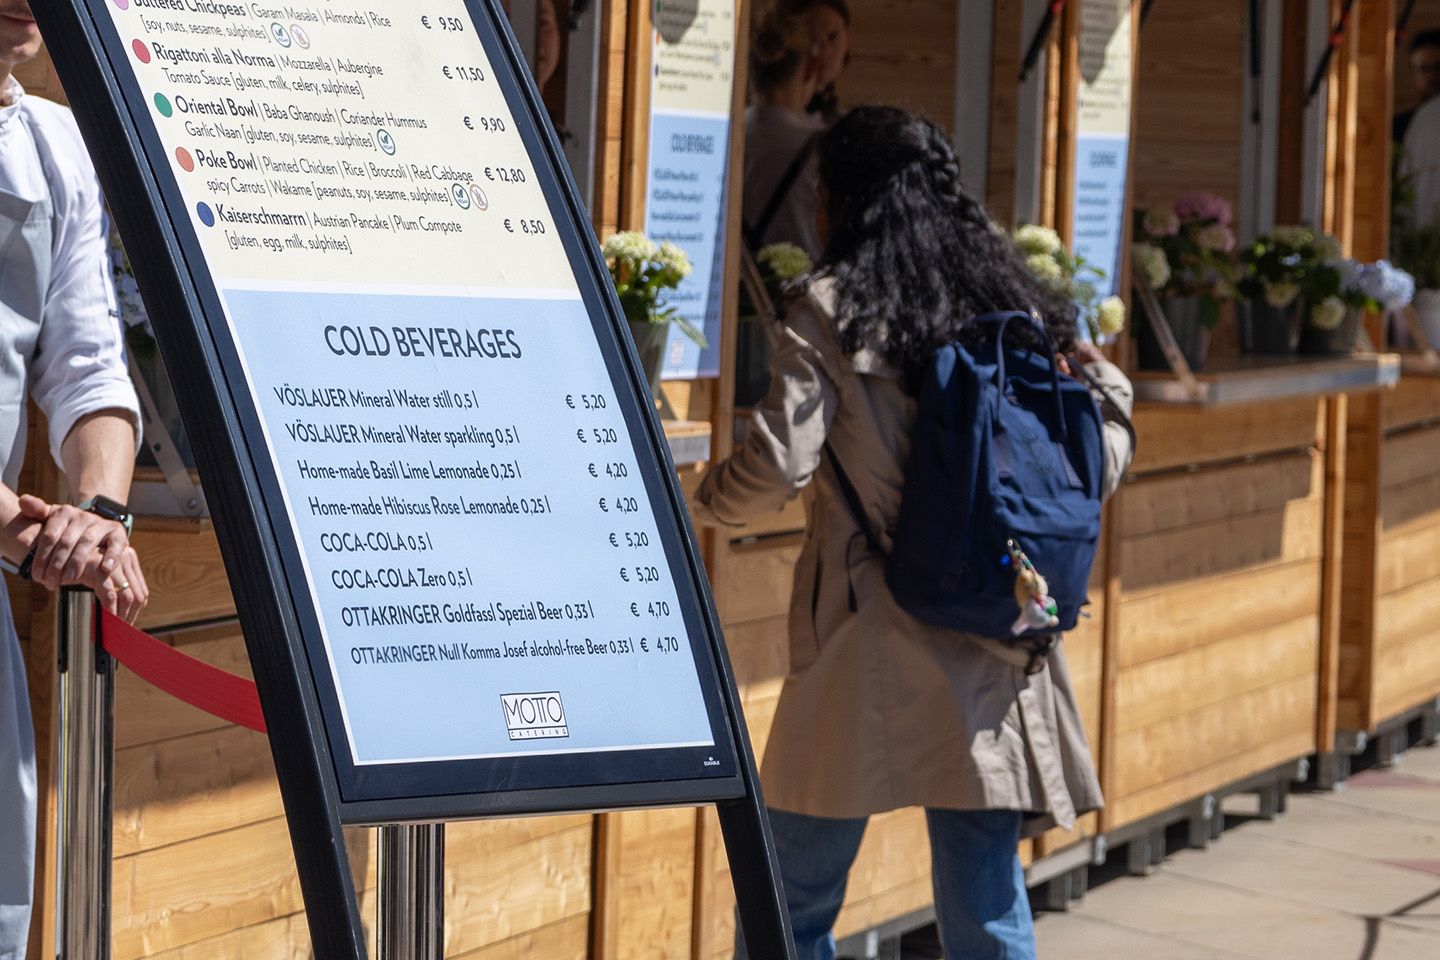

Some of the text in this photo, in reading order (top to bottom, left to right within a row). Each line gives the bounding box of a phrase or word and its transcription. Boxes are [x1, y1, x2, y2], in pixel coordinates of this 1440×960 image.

[139, 14, 272, 43] [soy, nuts, sesame, sulphites]
[251, 3, 285, 19] Garam
[284, 6, 319, 22] Masala
[324, 9, 367, 25] Almonds
[369, 11, 392, 28] Rice
[421, 15, 432, 30] €
[438, 16, 464, 32] 9,50
[152, 42, 485, 83] Rigattoni alla Norma Mozzarella Aubergine € 11,50
[161, 67, 365, 99] Tomato Sauce [gluten, milk, celery, sulphites]
[175, 95, 506, 133] Oriental Bowl Baba Ghanoush Coriander Hummus € 9,90
[184, 121, 378, 152] Garlic Naan [gluten, soy, sesame, sulphites]
[195, 148, 527, 184] Poke Bowl Planted Chicken Rice Broccoli Red Cabbage € 12,80
[206, 176, 454, 207] spicy Carrots Wakame [peanuts, soy, sesame, sulphites]
[215, 203, 546, 236] Kaiserschmarrn Austrian Pancake Plum Compote € 8,50
[224, 229, 353, 254] [gluten, egg, milk, sulphites]
[323, 325, 523, 359] COLD BEVERAGES
[273, 383, 350, 408] VÖSLAUER
[349, 388, 395, 408] Mineral
[393, 388, 433, 408] Water
[434, 390, 453, 408] still
[453, 392, 473, 411] 0,5
[565, 395, 576, 410] €
[582, 394, 607, 411] 5,20
[285, 418, 360, 444] VÖSLAUER
[359, 424, 406, 444] Mineral
[404, 424, 442, 444] Water
[444, 424, 496, 449] sparkling
[495, 428, 514, 446] 0,5
[576, 429, 588, 444] €
[593, 428, 618, 446] 5,20
[297, 459, 371, 480] Home-made
[370, 460, 400, 480] Basil
[399, 460, 430, 480] Lime
[429, 460, 490, 480] Lemonade
[490, 463, 516, 481] 0,25
[588, 463, 599, 478] €
[605, 462, 628, 480] 4,20
[308, 496, 383, 516] Home-made
[381, 496, 432, 516] Hibiscus
[430, 496, 461, 516] Rose
[459, 495, 520, 515] Lemonade
[520, 498, 545, 516] 0,25
[599, 497, 609, 512] €
[616, 497, 639, 515] 4,20
[320, 532, 408, 552] COCA-COLA
[407, 535, 428, 553] 0,5
[609, 533, 619, 547] €
[625, 532, 649, 550] 5,20
[331, 568, 419, 590] COCA-COLA
[417, 568, 447, 587] Zero
[447, 571, 467, 589] 0,5
[620, 567, 630, 582] €
[636, 566, 660, 584] 5,20
[341, 604, 442, 627] OTTAKRINGER
[443, 603, 498, 624] Goldfassl
[496, 601, 538, 626] Spezial
[536, 601, 564, 621] Beer
[564, 603, 588, 622] 0,33
[630, 602, 641, 617] €
[647, 601, 670, 619] 4,70
[351, 636, 680, 665] OTTAKRINGER Null Komma Josef alcohol-free Beer 0,33 € 4,70
[503, 696, 563, 726] MOTTO
[510, 728, 567, 738] CATERING
